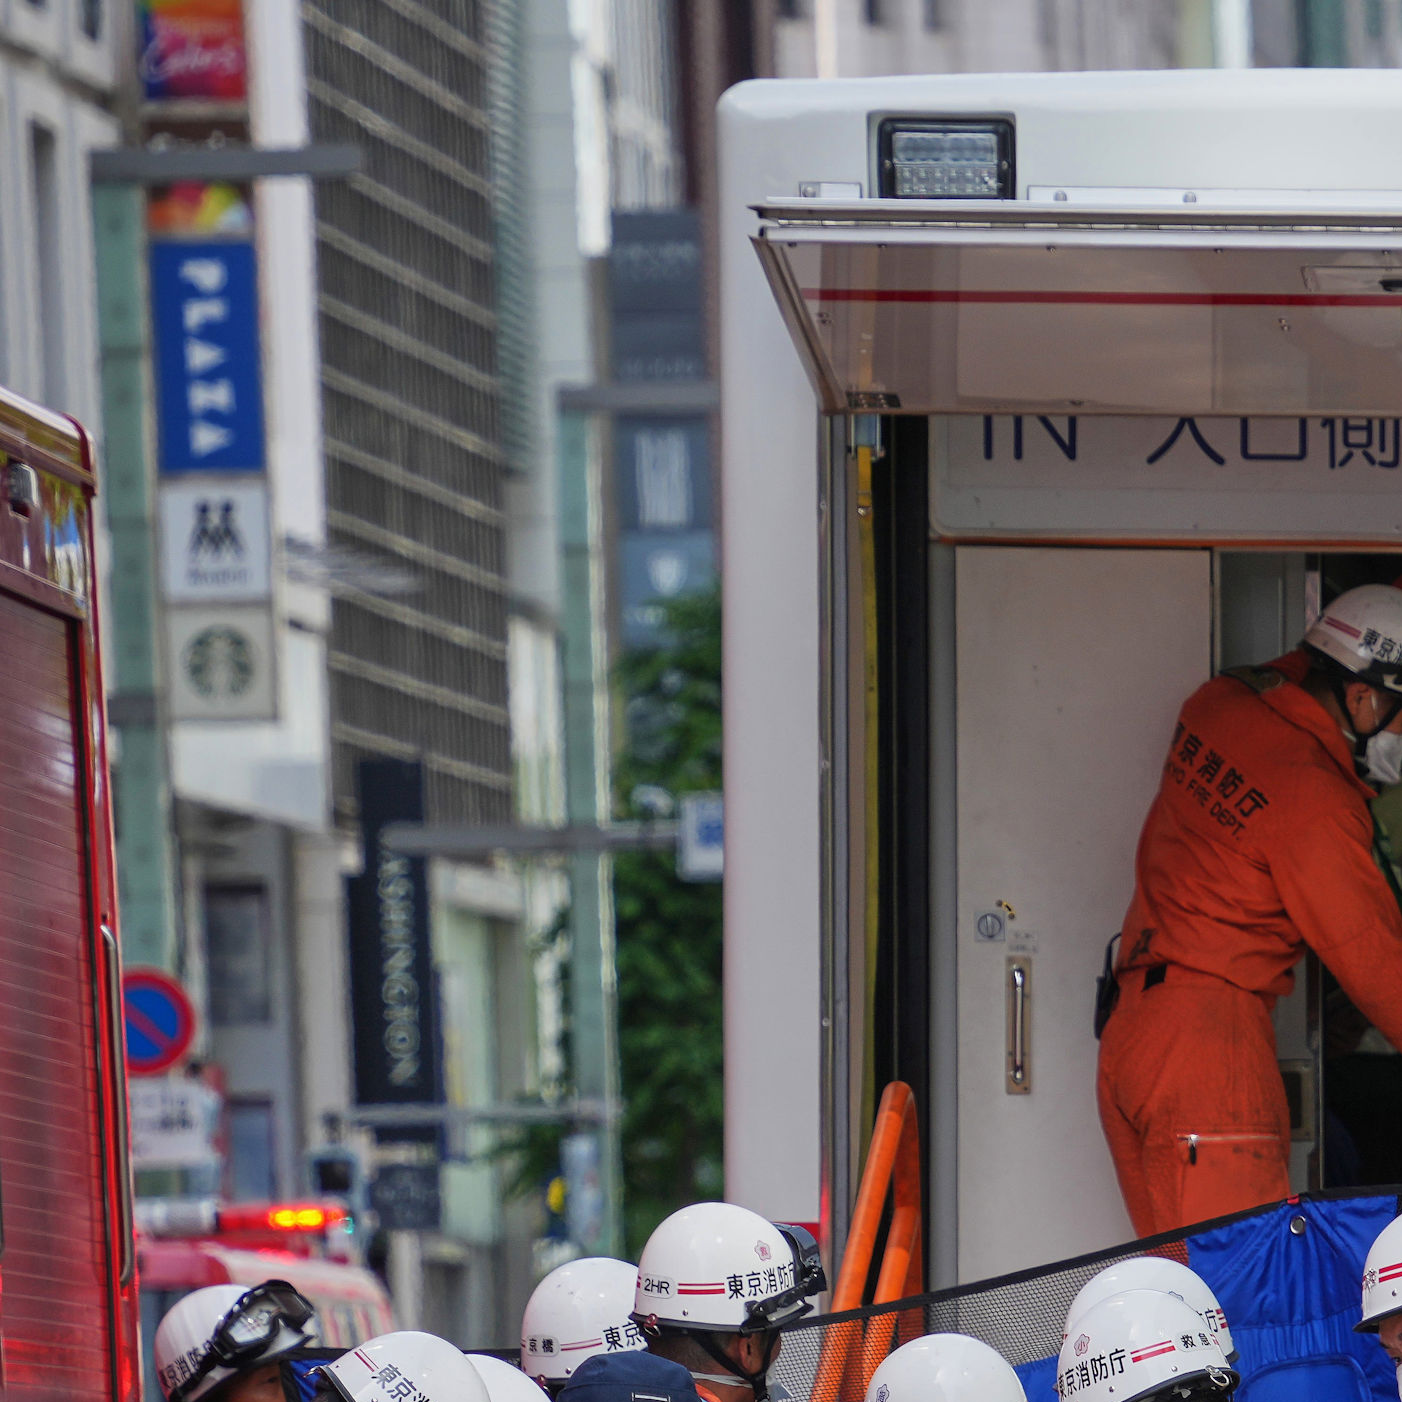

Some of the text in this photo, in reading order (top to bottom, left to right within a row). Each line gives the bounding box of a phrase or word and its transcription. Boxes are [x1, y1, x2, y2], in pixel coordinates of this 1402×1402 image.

[177, 257, 237, 459] PLAZA
[377, 846, 421, 1087] ASHINGTON
[644, 1277, 671, 1295] 2HR
[1057, 1348, 1126, 1401] 東京消防庁
